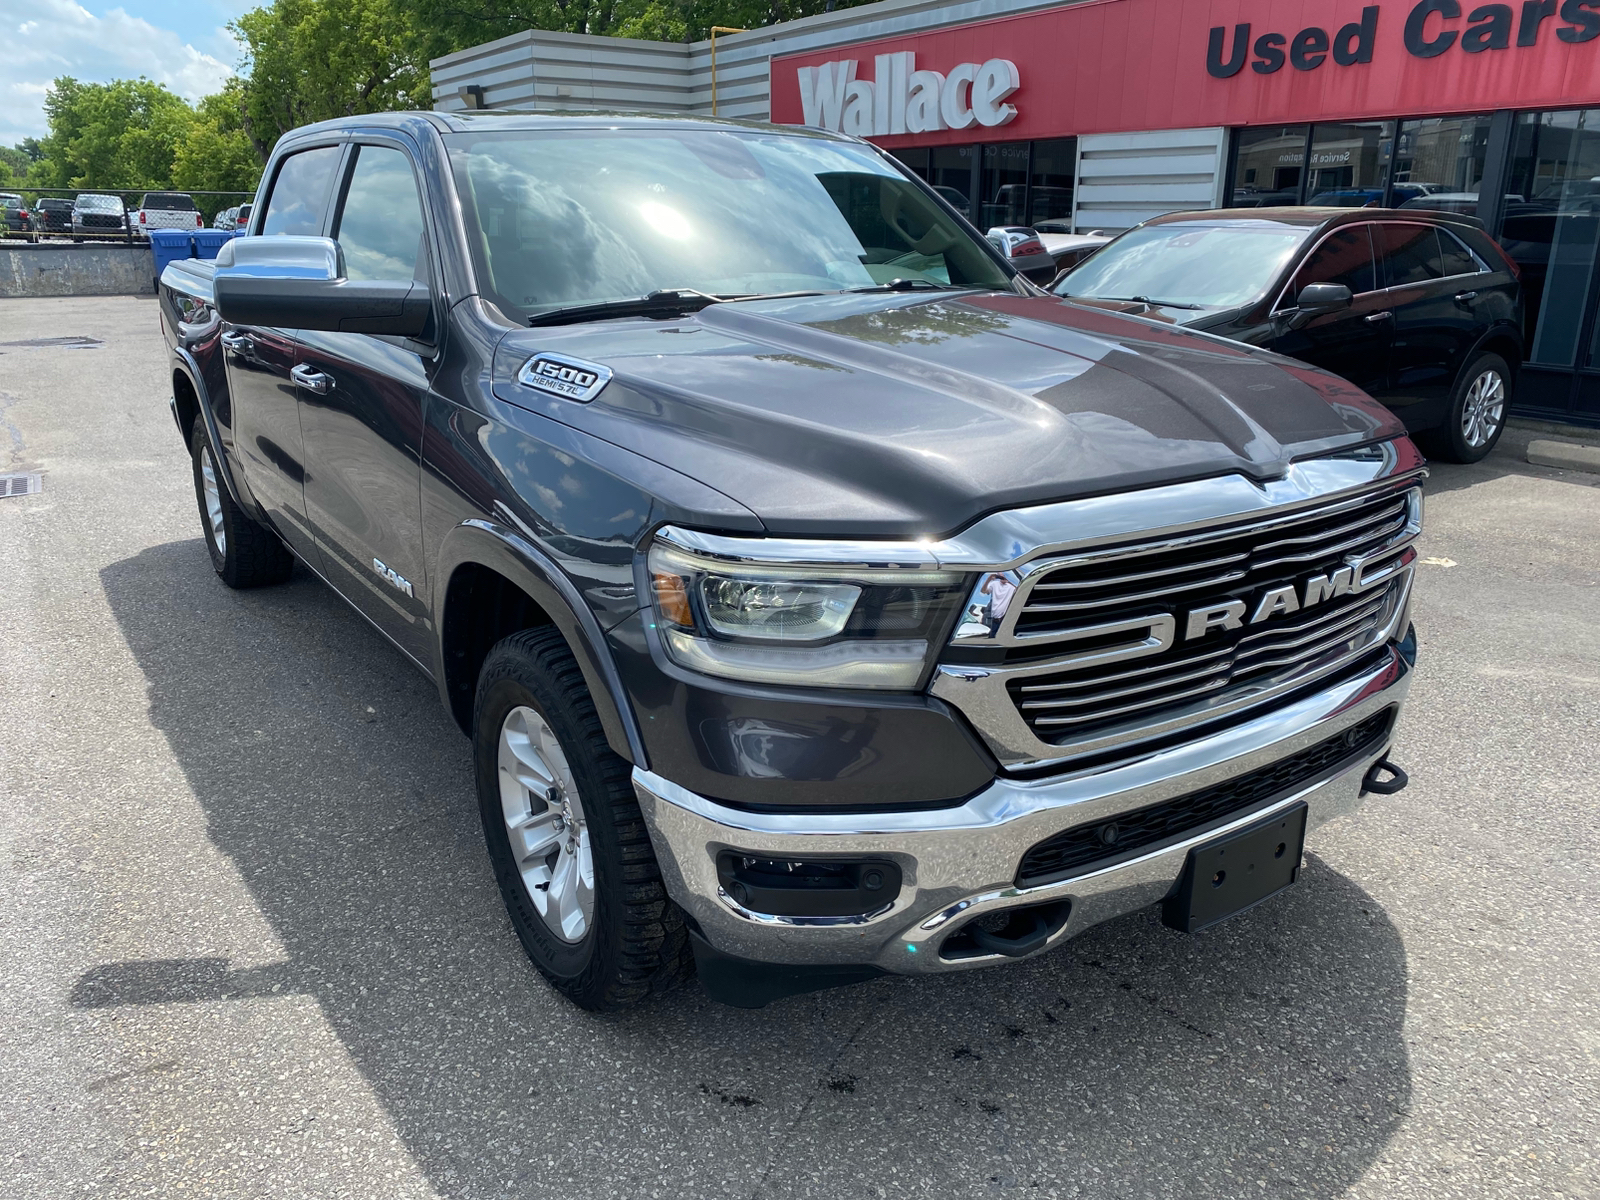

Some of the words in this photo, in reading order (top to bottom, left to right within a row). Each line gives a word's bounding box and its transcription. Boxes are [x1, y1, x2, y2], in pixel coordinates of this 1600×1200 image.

[1206, 4, 1380, 79] Used
[1403, 0, 1600, 59] Cars
[797, 51, 1020, 138] Wallace
[532, 376, 557, 389] HEMI
[557, 383, 579, 395] 5.7L
[536, 361, 596, 386] 1500
[373, 557, 413, 598] RAM
[1185, 565, 1352, 642] RAM
